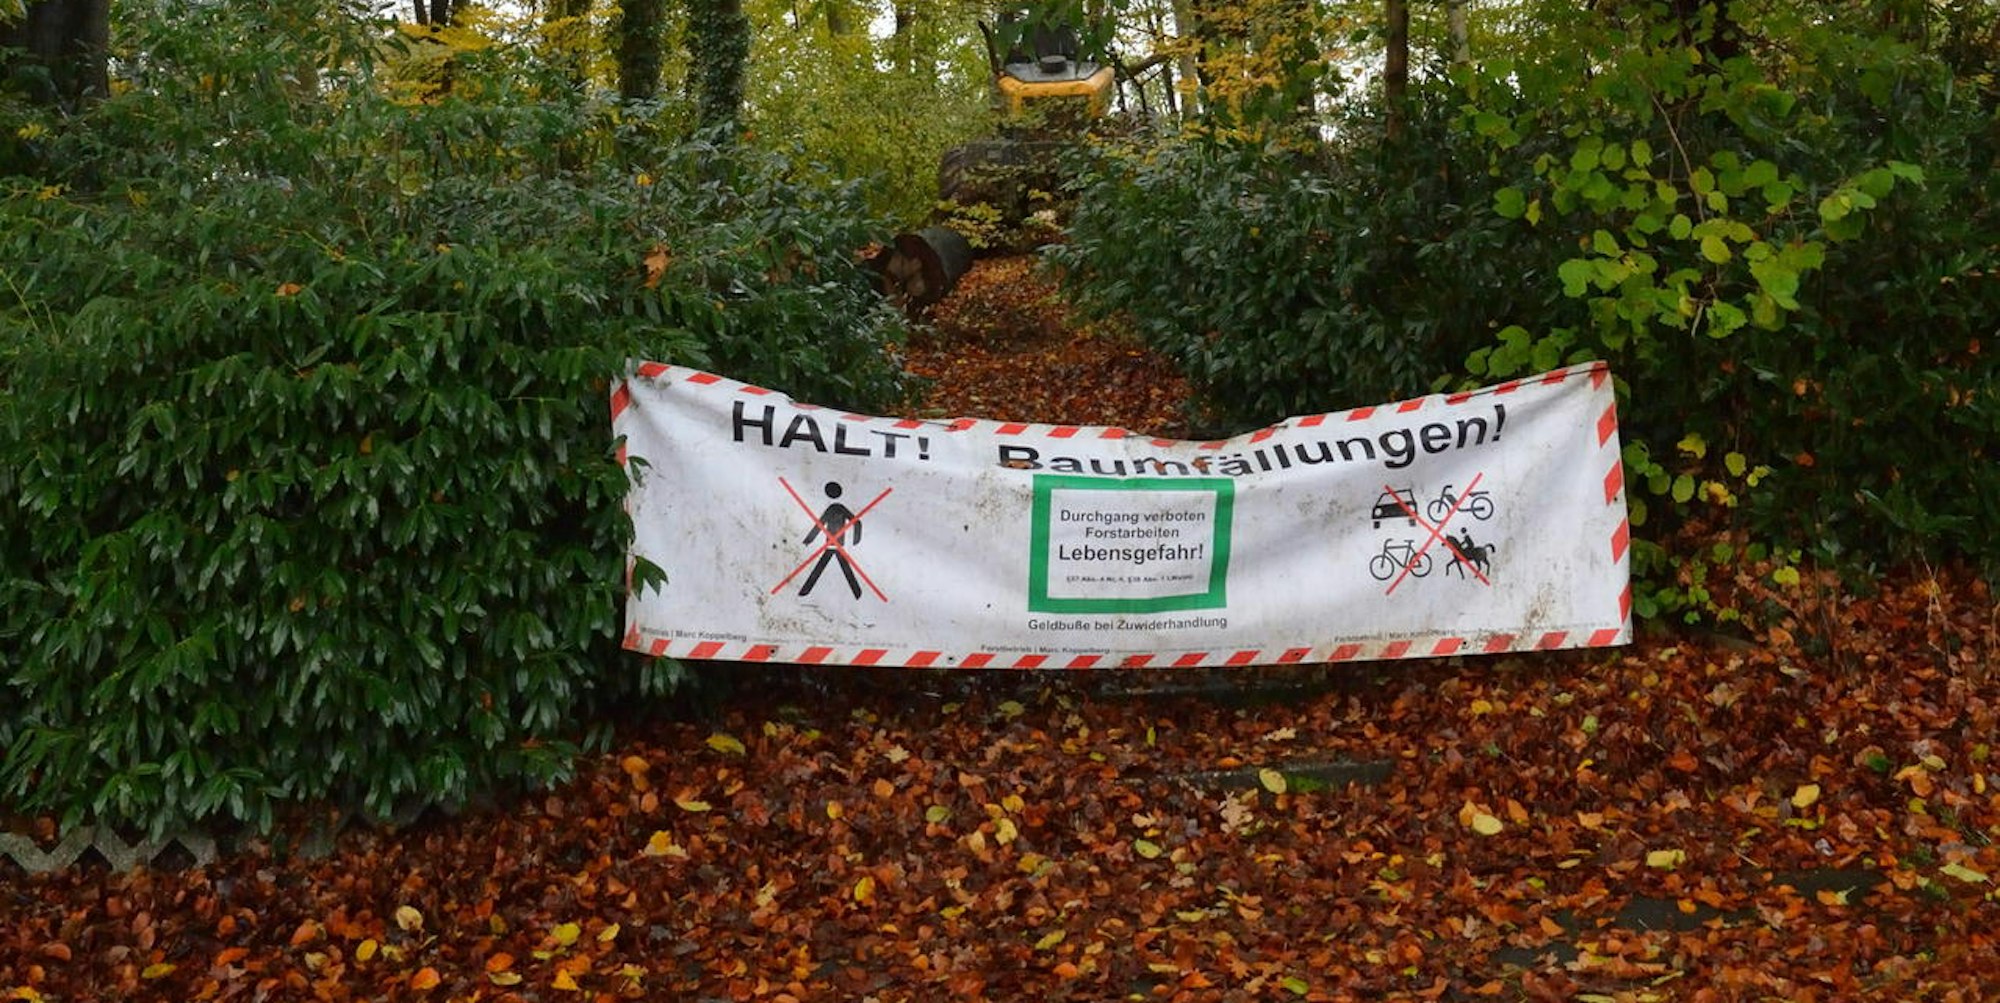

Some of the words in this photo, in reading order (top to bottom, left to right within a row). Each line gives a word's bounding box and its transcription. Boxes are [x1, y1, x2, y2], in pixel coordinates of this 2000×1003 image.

[732, 400, 930, 461] HALT!
[997, 403, 1507, 477] Baumfällungen!
[1060, 509, 1139, 524] Durchgang
[1144, 508, 1206, 522] verboten
[1085, 526, 1180, 539] Forstarbeiten
[1058, 543, 1203, 565] Lebensgefahr!
[1028, 618, 1090, 631] Geldbuße
[1094, 618, 1113, 631] bei
[1117, 616, 1228, 630] Zuwiderhandlung
[675, 629, 697, 638] Marc
[698, 631, 747, 642] Koppelberg
